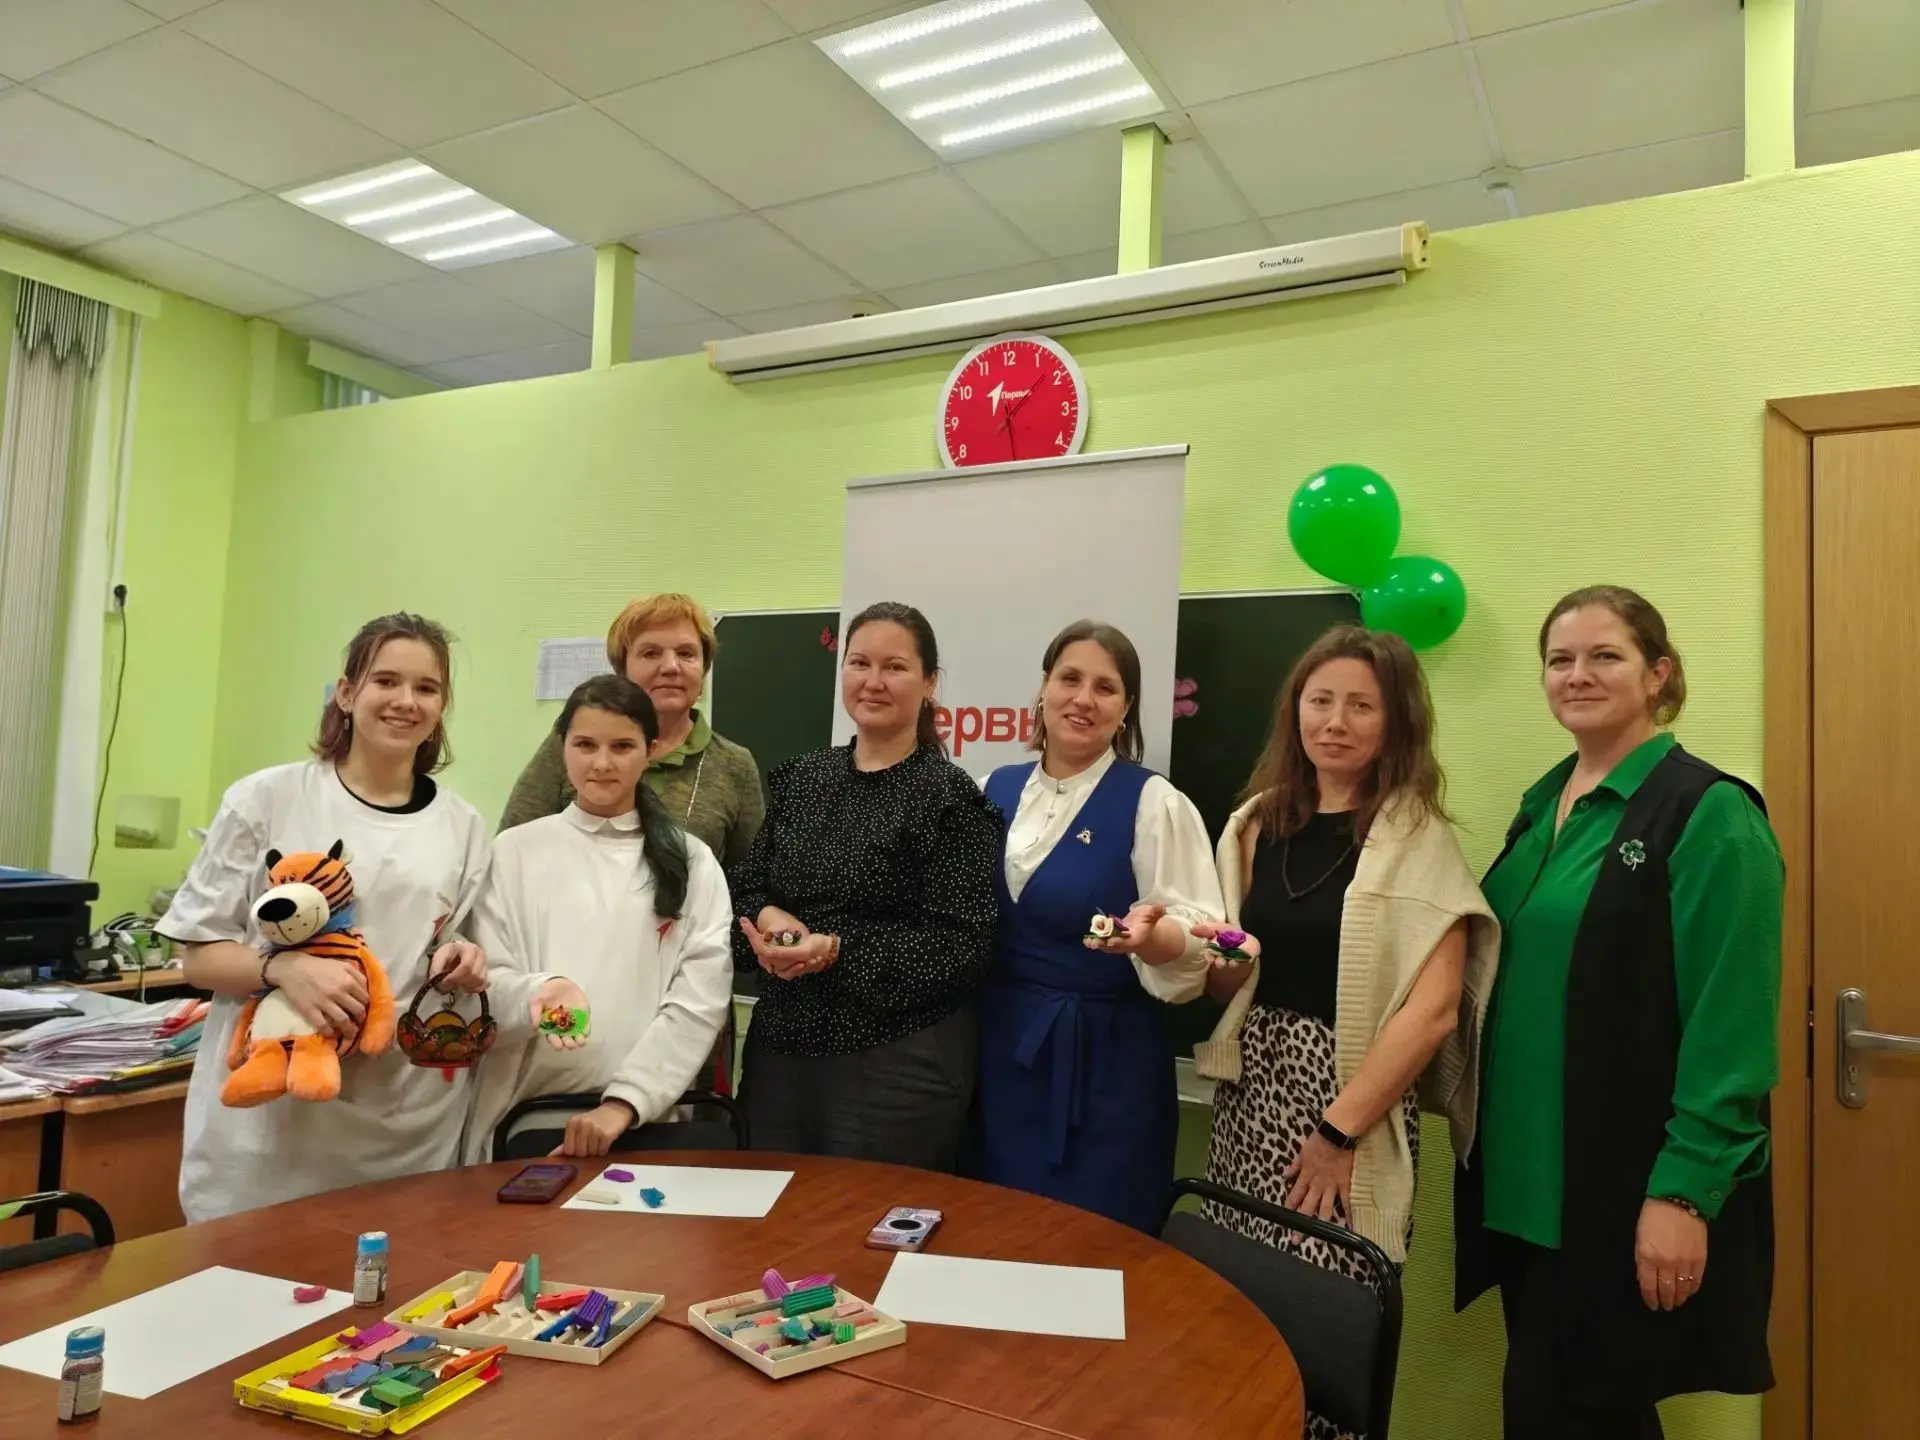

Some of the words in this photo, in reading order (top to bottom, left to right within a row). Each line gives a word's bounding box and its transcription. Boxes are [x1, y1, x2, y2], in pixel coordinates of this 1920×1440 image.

[1003, 350, 1016, 366] 12
[1035, 353, 1040, 368] 1
[979, 361, 989, 376] 11
[1053, 370, 1062, 386] 2
[959, 385, 972, 400] 10
[1061, 401, 1070, 416] 3
[951, 417, 959, 431] 9
[1054, 431, 1064, 445] 4
[959, 444, 967, 458] 8
[934, 706, 1036, 757] ерв
